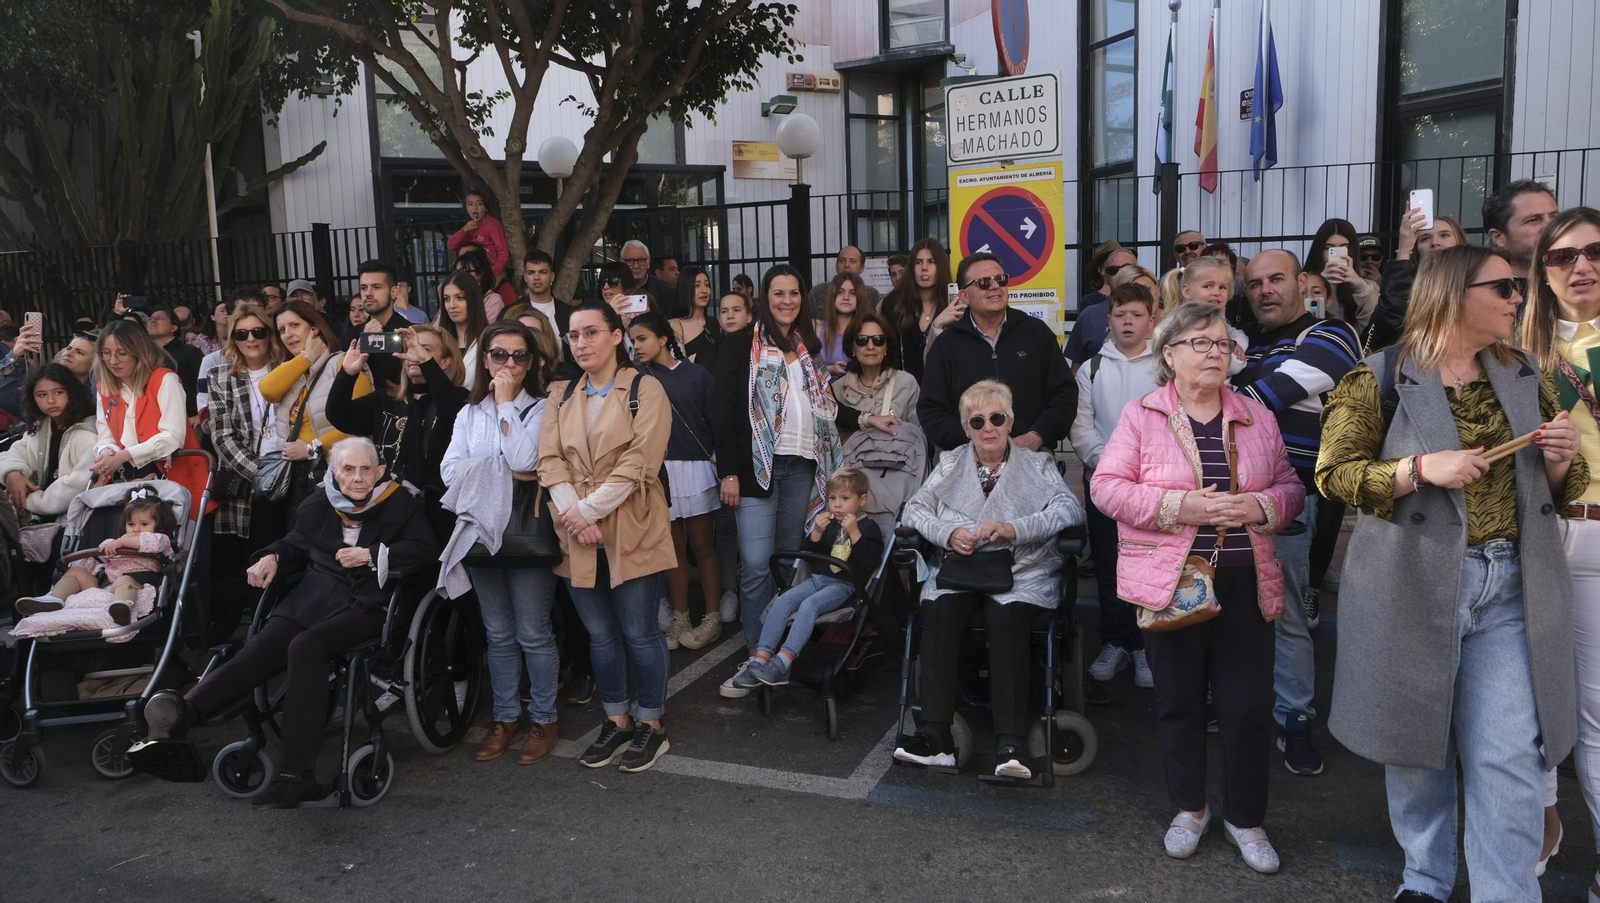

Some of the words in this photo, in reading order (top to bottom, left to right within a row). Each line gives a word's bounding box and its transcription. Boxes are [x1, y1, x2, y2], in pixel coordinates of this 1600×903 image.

[979, 84, 1044, 105] CALLE
[956, 105, 1047, 132] HERMANOS
[962, 129, 1043, 155] MACHADO
[979, 174, 1020, 182] AYUNTAMIENTO
